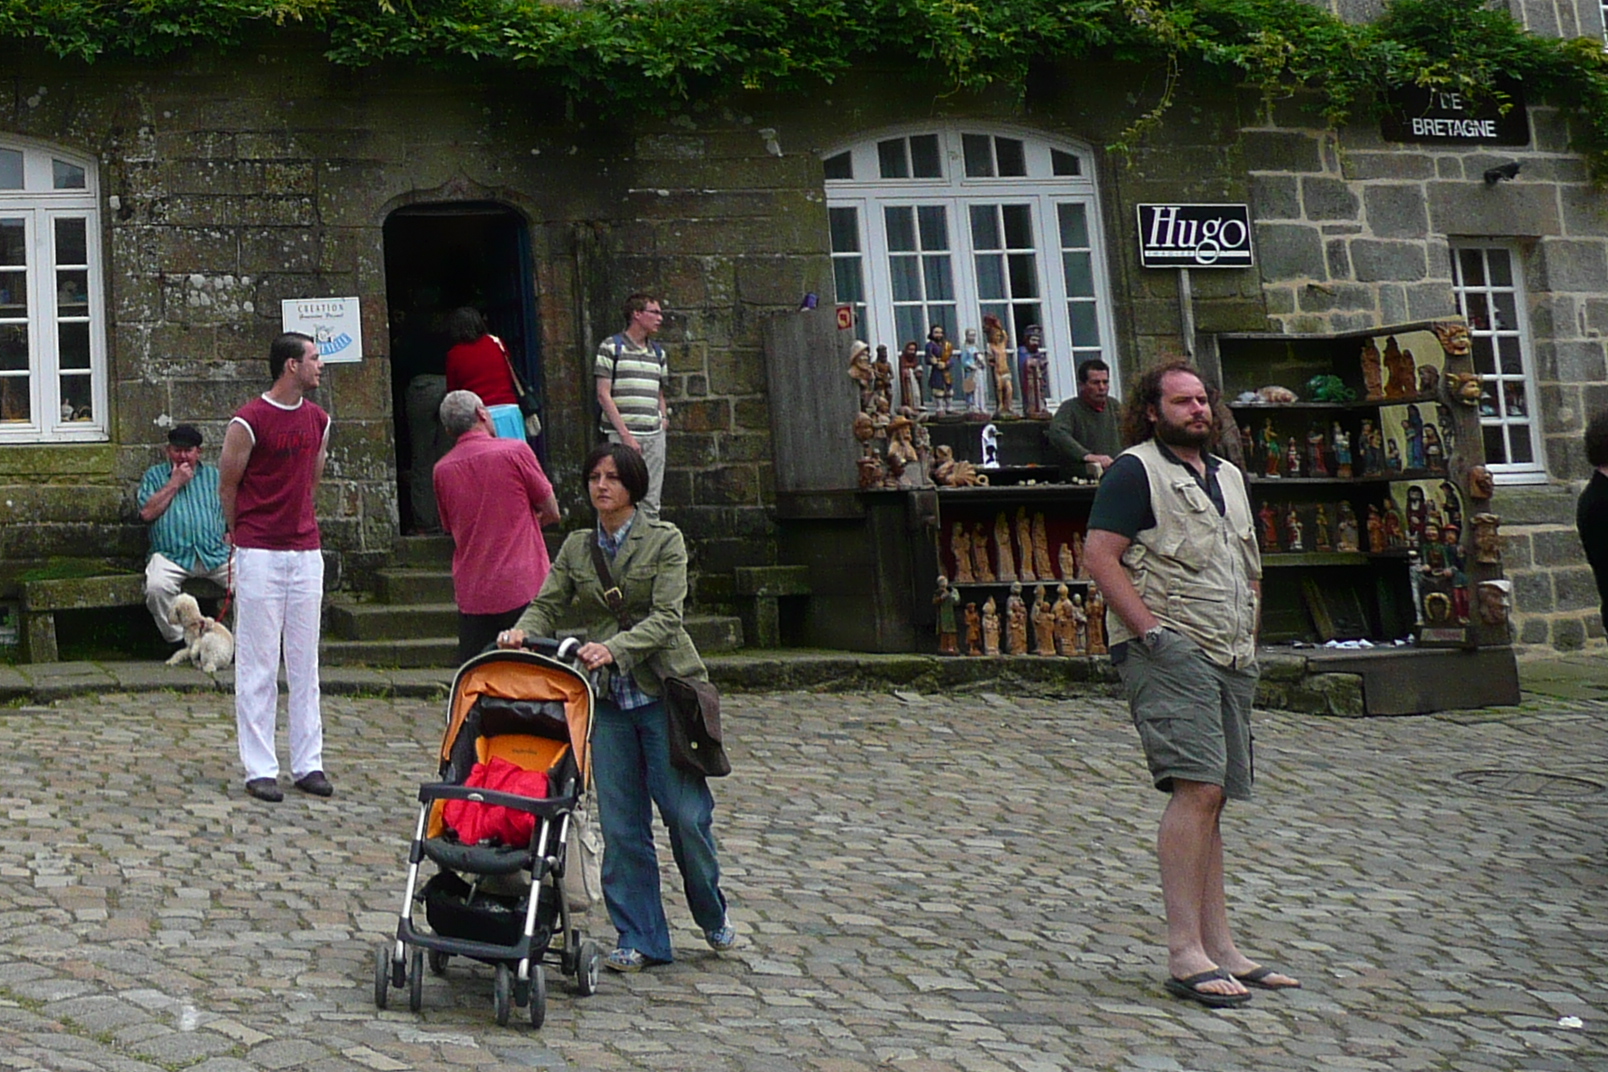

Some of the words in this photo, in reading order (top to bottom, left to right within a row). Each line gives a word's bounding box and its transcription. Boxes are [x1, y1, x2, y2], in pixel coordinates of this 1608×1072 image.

[1412, 117, 1498, 138] BRETAGNE
[1145, 206, 1247, 264] Hugo
[297, 303, 345, 313] CREATION
